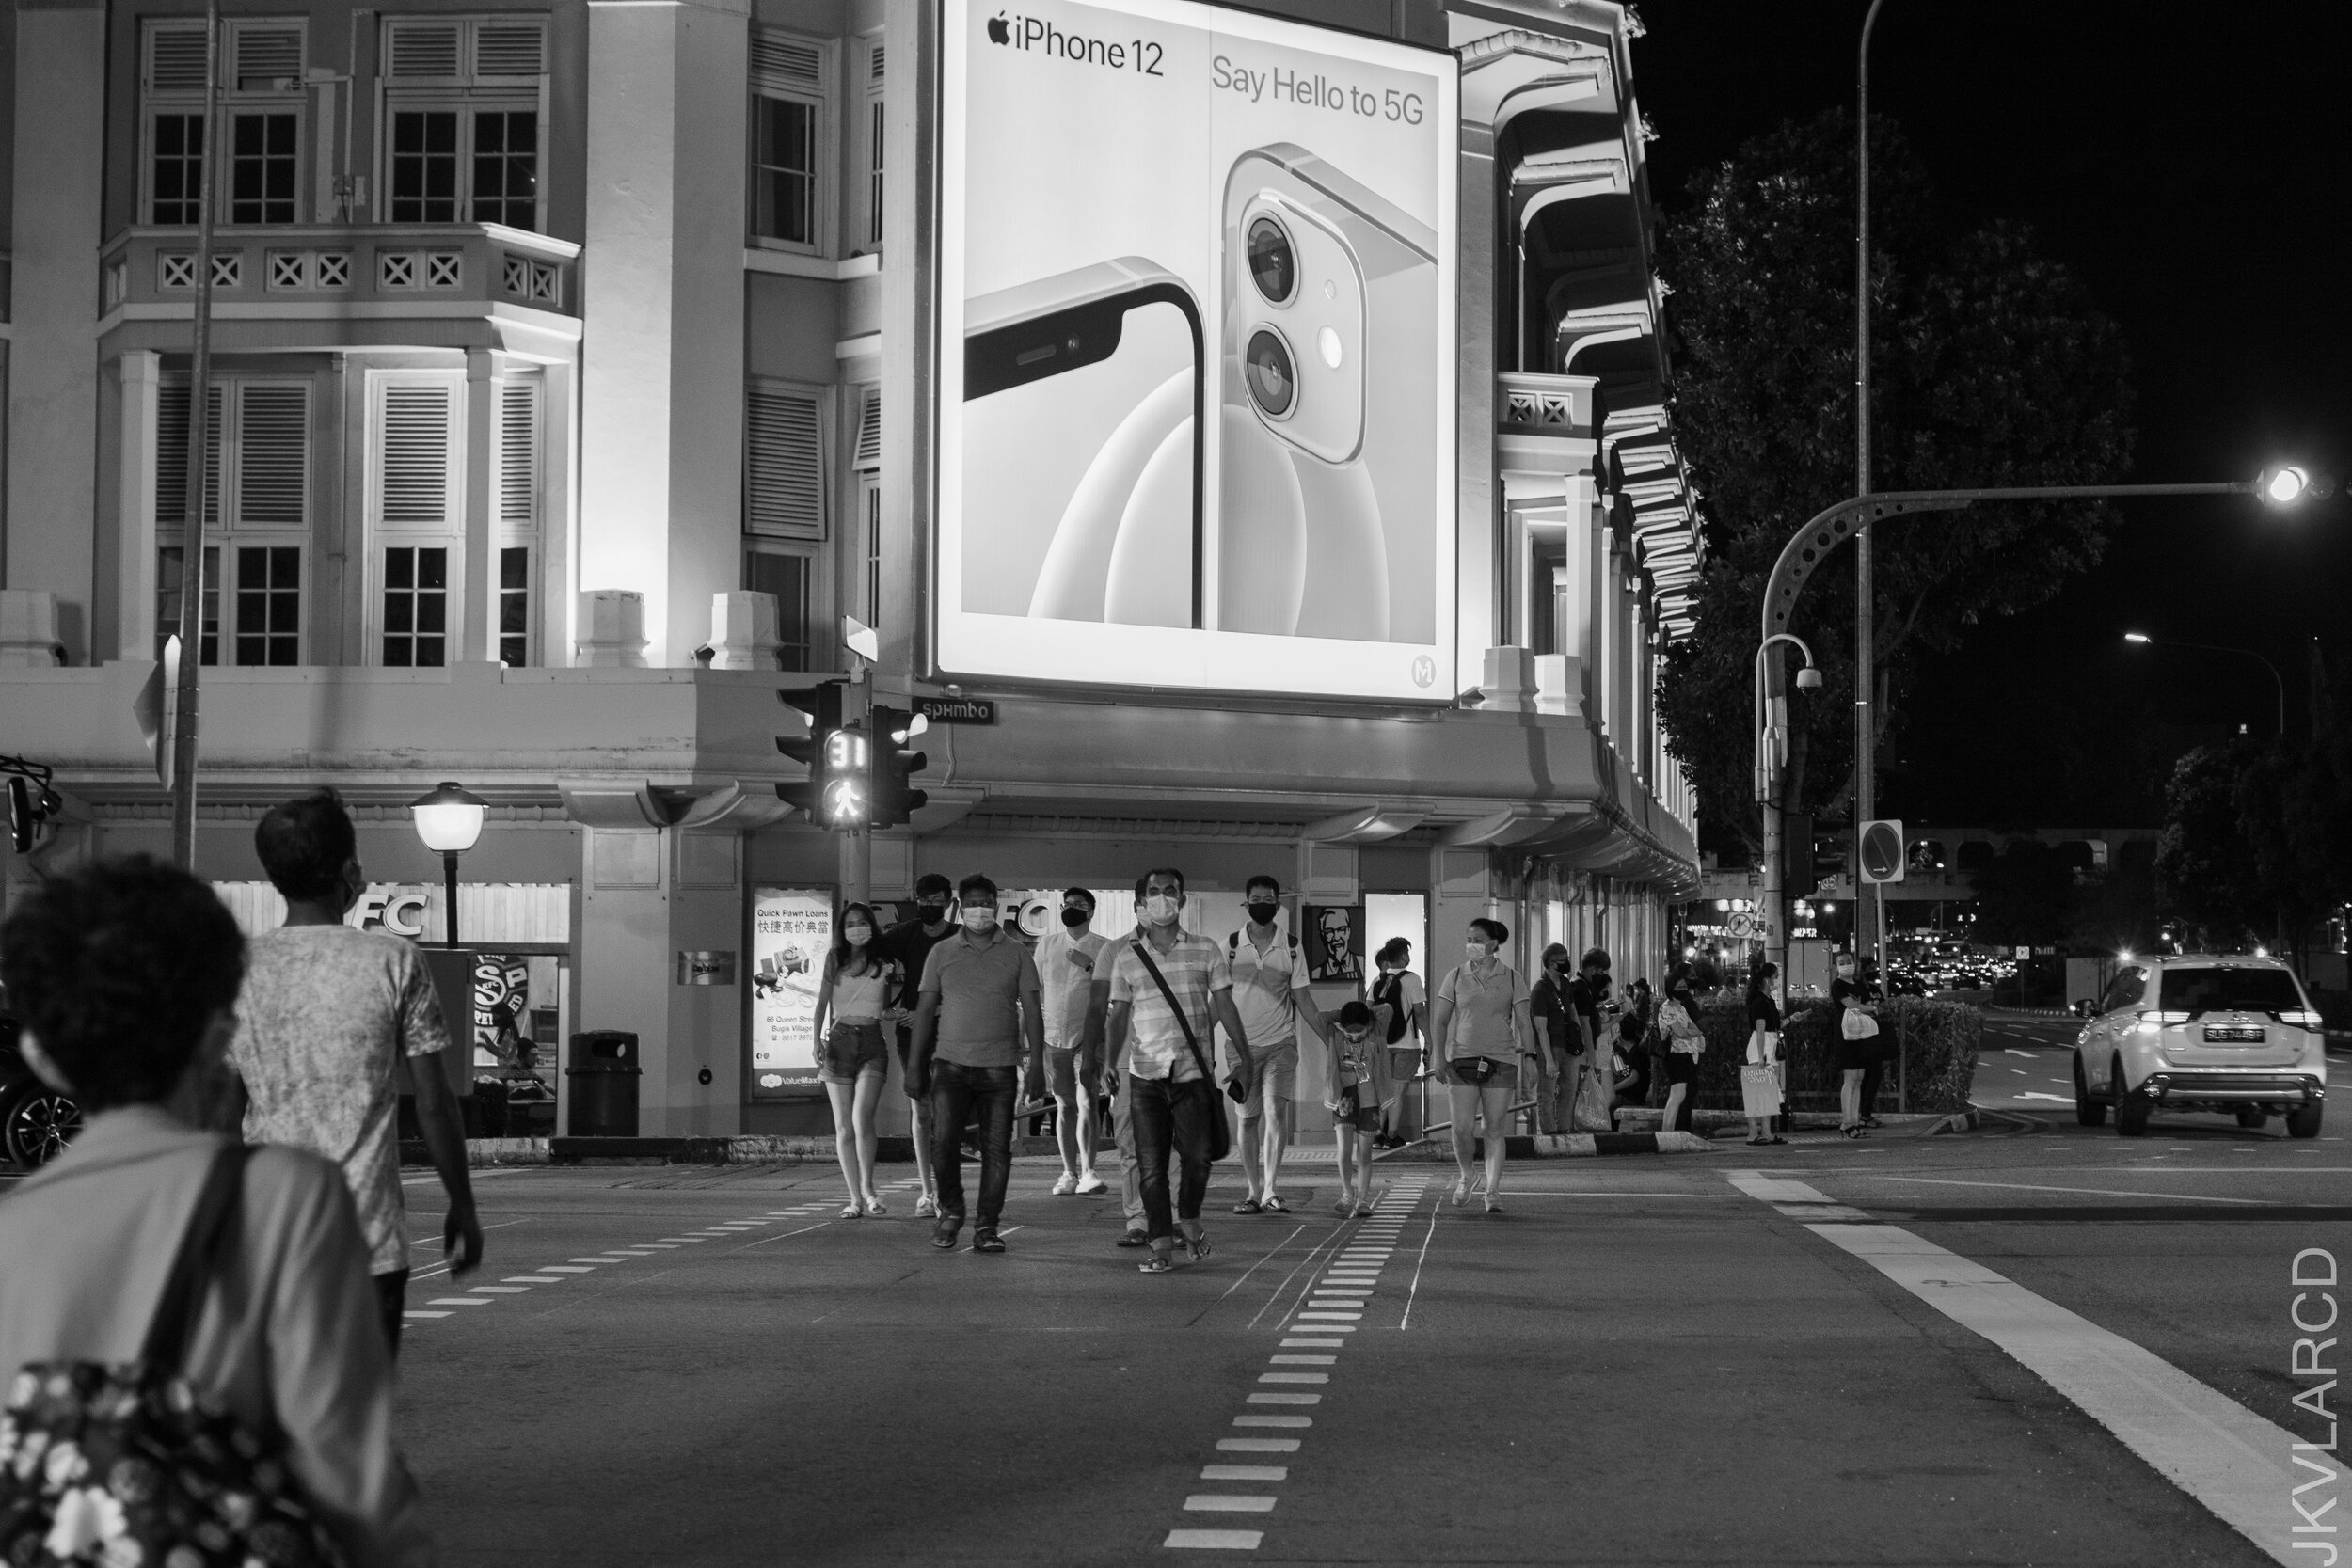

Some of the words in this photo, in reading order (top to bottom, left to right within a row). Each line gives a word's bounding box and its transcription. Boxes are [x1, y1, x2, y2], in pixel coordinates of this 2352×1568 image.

[1016, 15, 1125, 69] iPhone
[1131, 40, 1164, 77] 12
[1212, 55, 1266, 103] Say
[1274, 67, 1344, 110] Hello
[1350, 85, 1376, 117] to
[1384, 88, 1423, 125] 5G
[831, 736, 866, 768] 31
[351, 894, 429, 937] FC
[757, 909, 780, 917] Quick
[782, 909, 803, 917] Pawn
